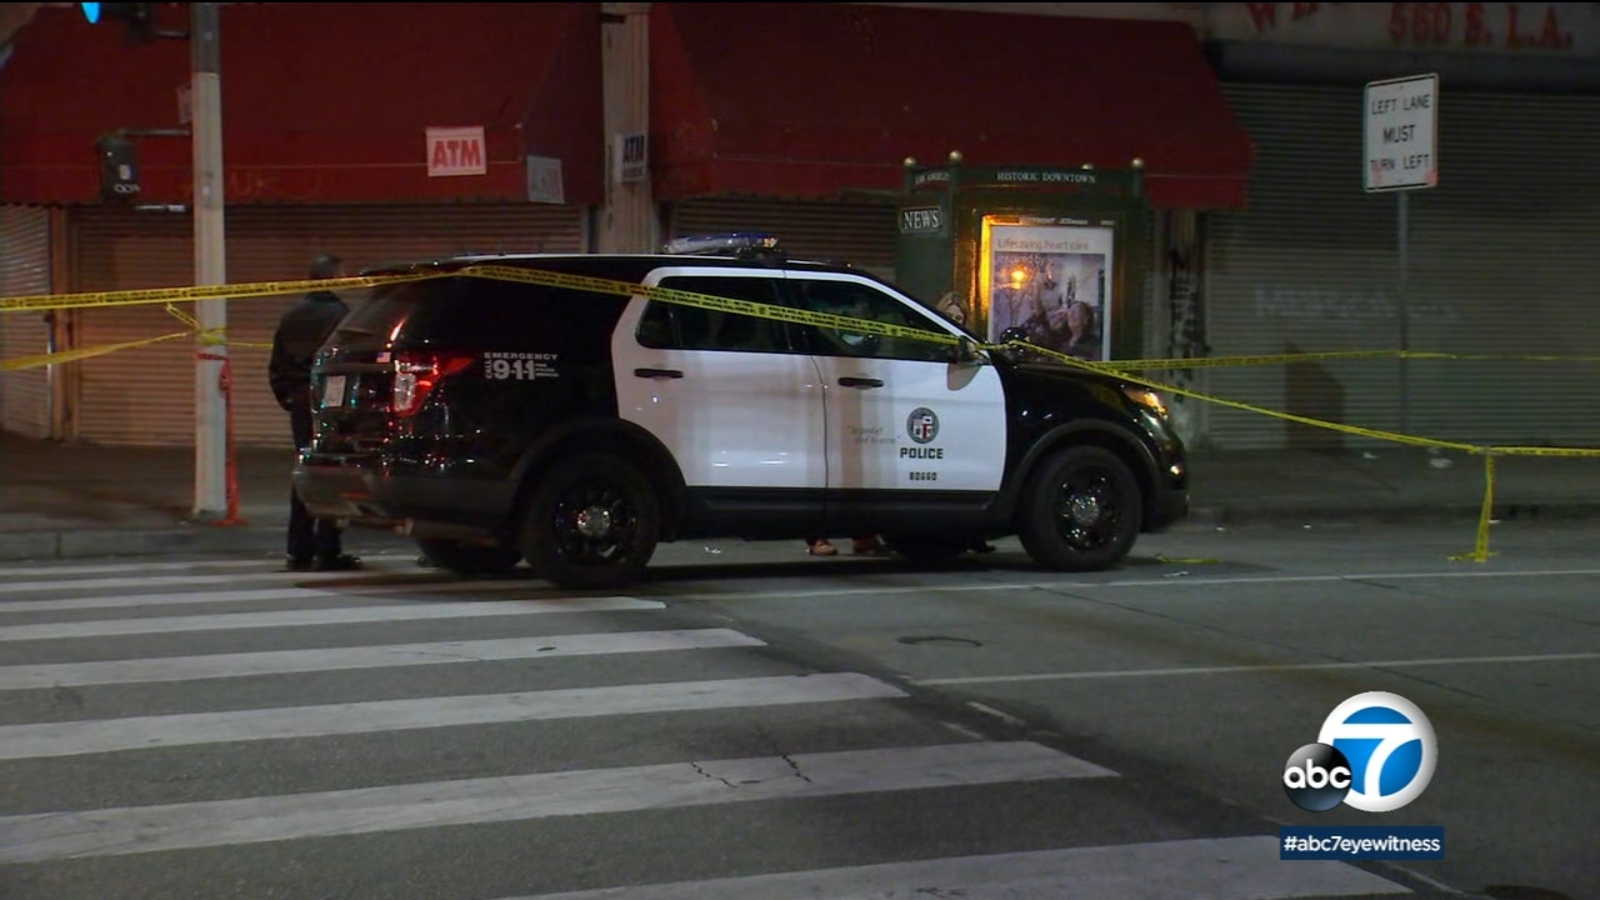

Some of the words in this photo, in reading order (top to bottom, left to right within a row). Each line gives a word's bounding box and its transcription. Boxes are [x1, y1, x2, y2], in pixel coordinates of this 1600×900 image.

[1371, 98, 1397, 115] LEFT
[1403, 94, 1431, 110] LANE
[1383, 124, 1416, 144] MUST
[432, 139, 482, 168] ATM
[623, 134, 645, 165] ATM
[1403, 154, 1430, 170] LEFT
[996, 171, 1038, 182] HISTORIC
[1042, 172, 1096, 184] DOWNTOWN
[903, 209, 941, 230] NEWS
[1044, 240, 1069, 252] heart
[484, 352, 558, 360] EMERGENCY
[493, 359, 535, 380] 9-1-1
[899, 447, 944, 460] POLICE
